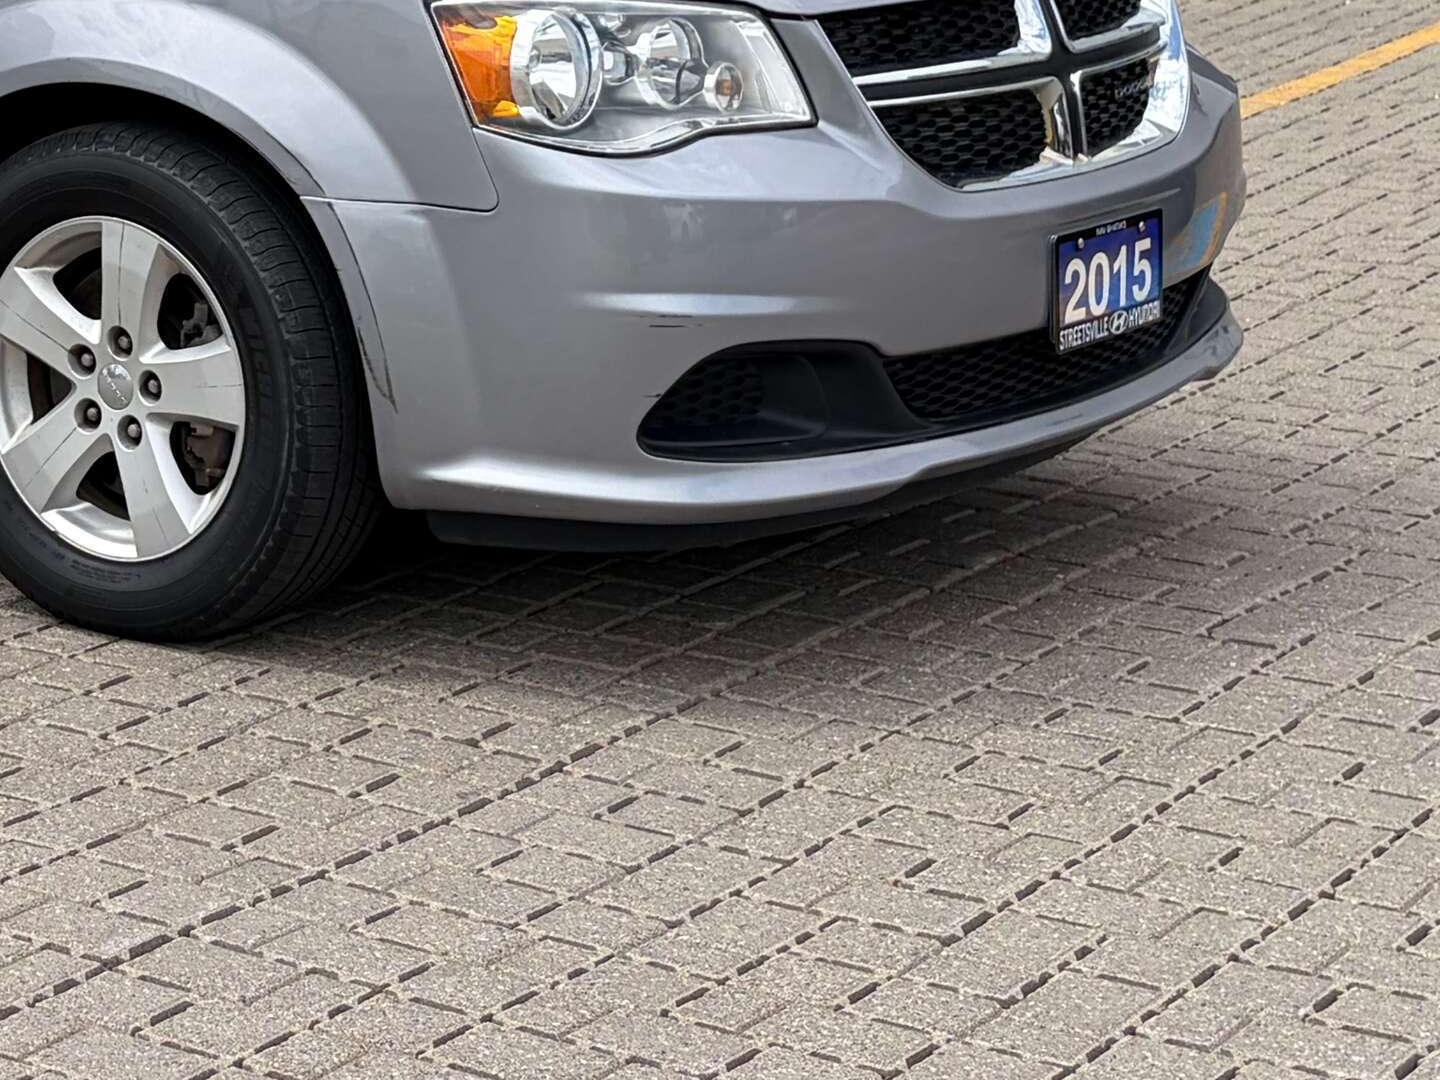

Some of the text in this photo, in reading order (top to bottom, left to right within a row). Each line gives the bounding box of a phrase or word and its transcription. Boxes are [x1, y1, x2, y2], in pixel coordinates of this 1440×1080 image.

[1064, 238, 1152, 323] 2015
[1059, 300, 1161, 350] STREETSVILLE HYUNDAI
